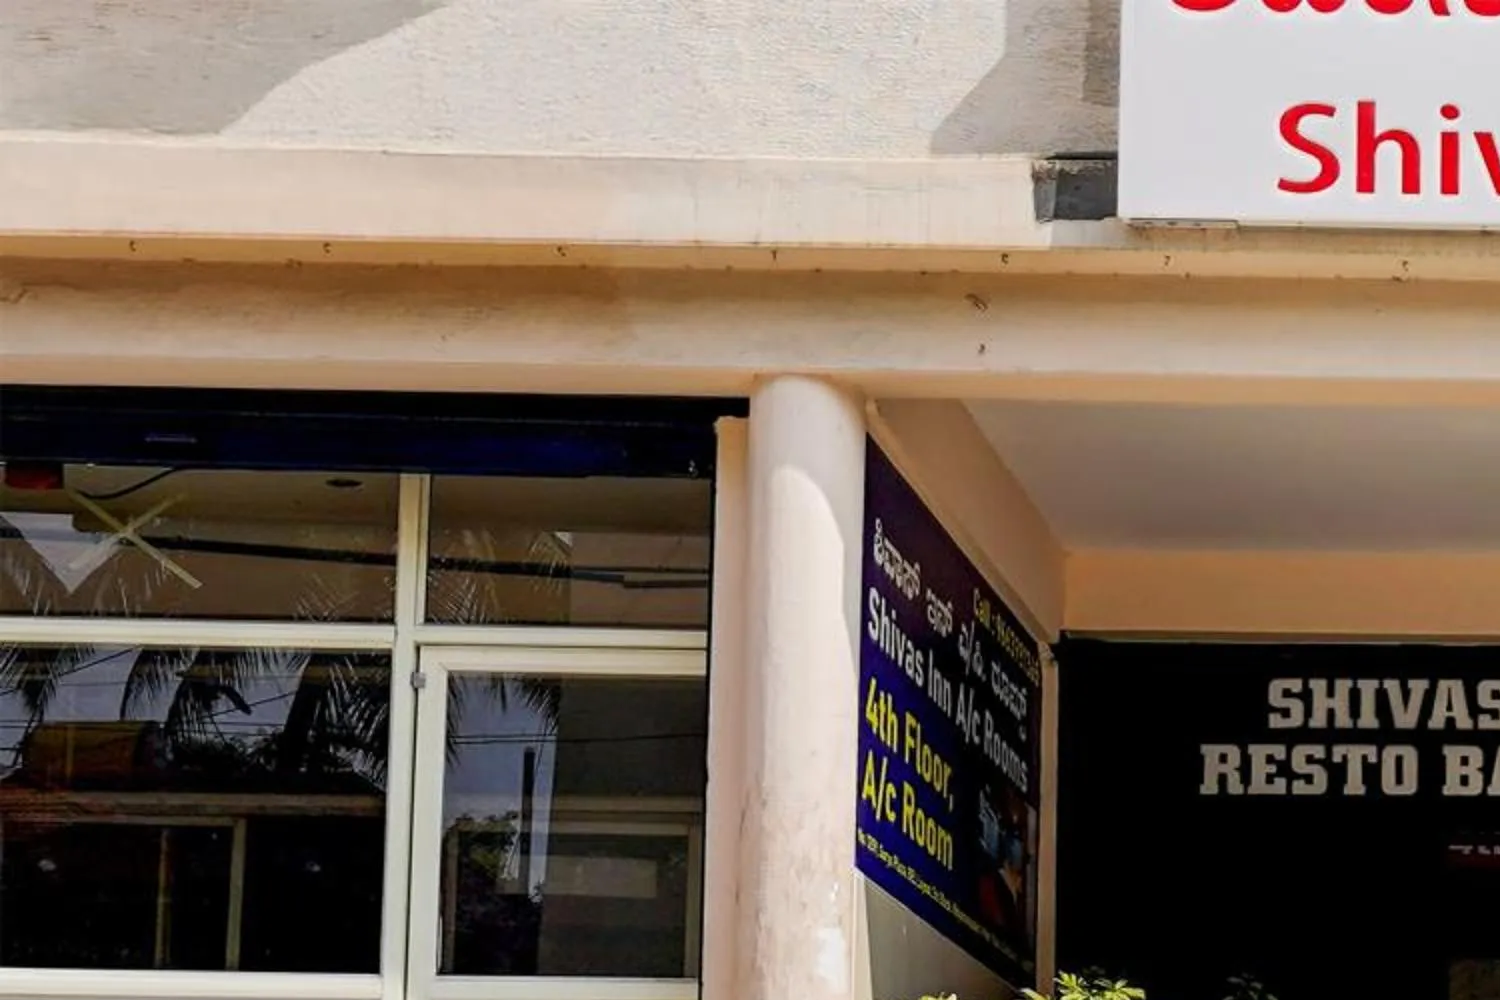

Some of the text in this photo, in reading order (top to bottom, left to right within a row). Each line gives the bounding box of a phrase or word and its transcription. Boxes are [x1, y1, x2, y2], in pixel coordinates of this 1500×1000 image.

[865, 677, 955, 811] 4th Floor,
[868, 586, 926, 688] Shivas
[927, 647, 953, 719] Inn
[955, 683, 982, 748] A/c
[983, 697, 1029, 794] Rooms
[862, 751, 954, 871] A/c Room
[1200, 744, 1419, 796] RESTO
